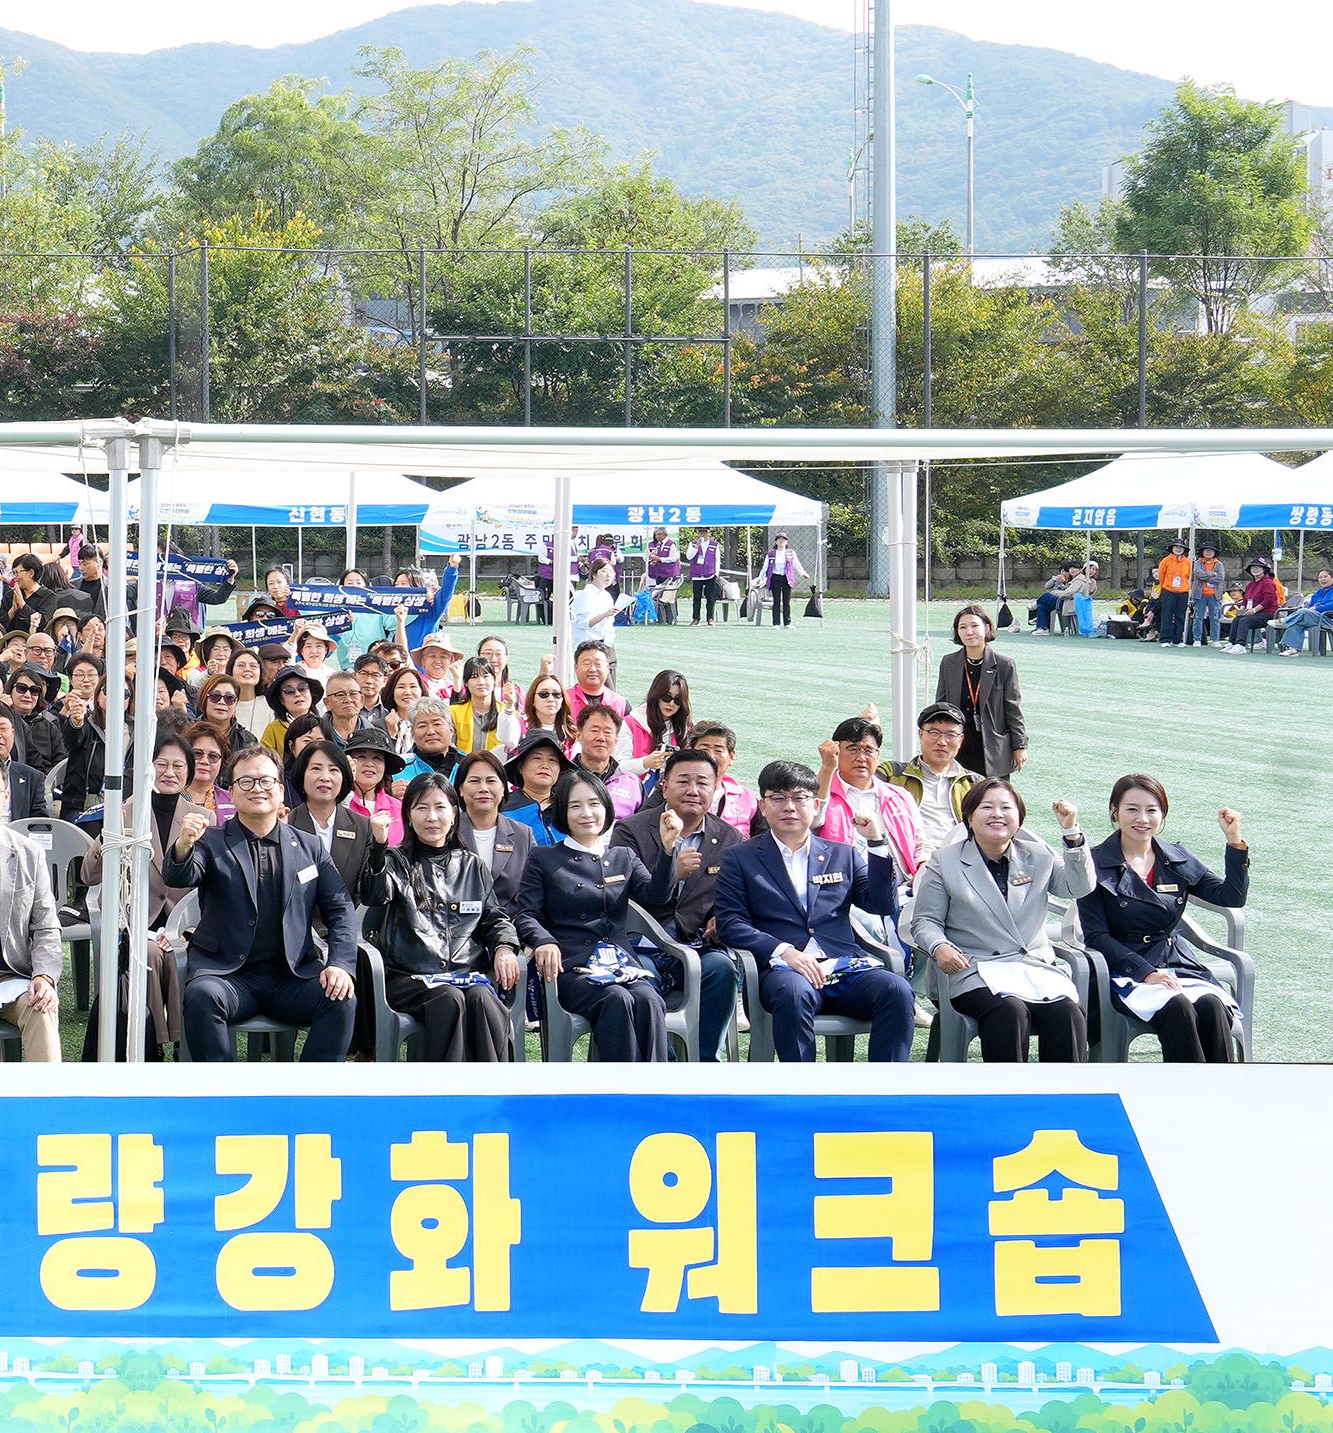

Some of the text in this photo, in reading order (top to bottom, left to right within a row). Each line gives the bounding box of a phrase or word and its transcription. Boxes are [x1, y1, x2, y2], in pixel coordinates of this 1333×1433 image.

[288, 506, 346, 523] 신현동
[627, 506, 702, 523] 광남2동
[1071, 508, 1117, 526] 곤지암읍
[1289, 505, 1333, 526] 쌍령동
[458, 533, 643, 552] 광남2동 주민치원회
[812, 872, 844, 885] 박지현
[629, 1130, 1124, 1316] 워크숍
